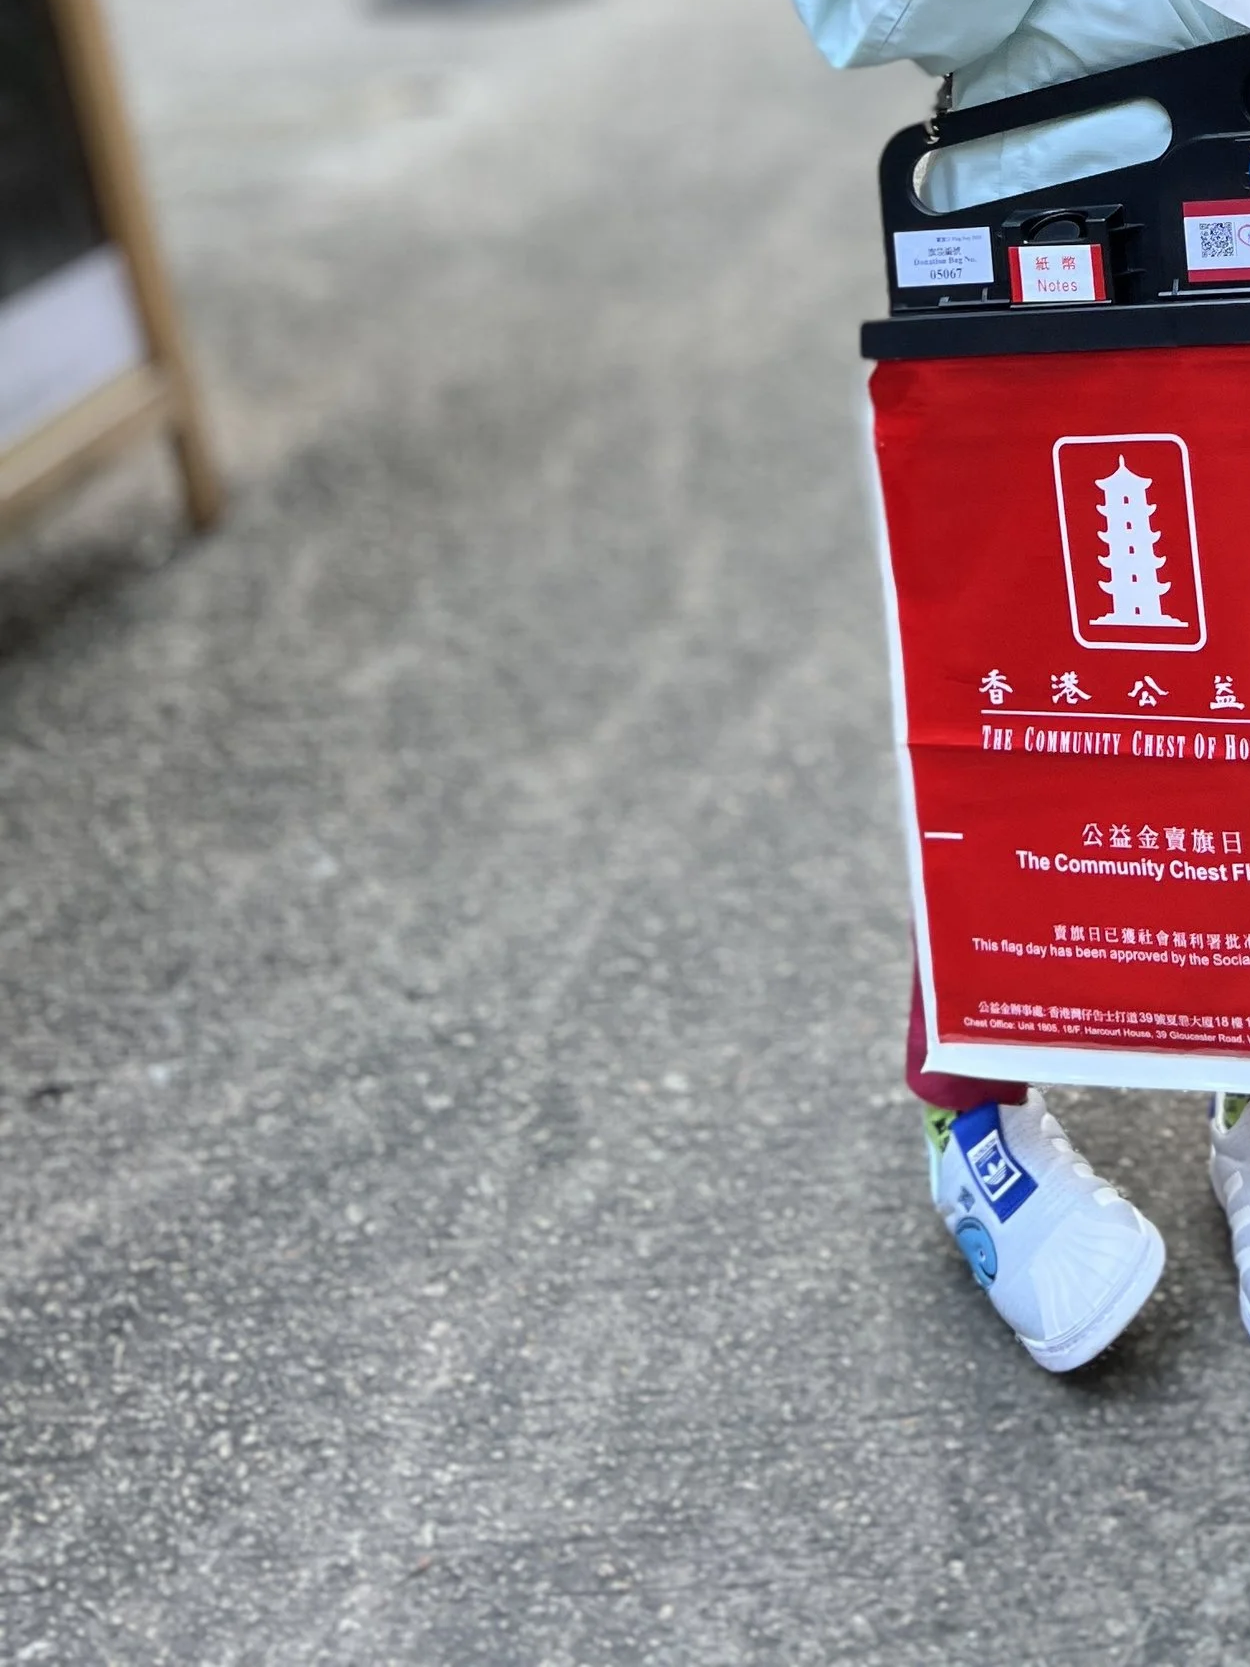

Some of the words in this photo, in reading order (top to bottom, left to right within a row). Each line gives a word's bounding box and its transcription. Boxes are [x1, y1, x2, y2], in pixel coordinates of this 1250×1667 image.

[914, 258, 947, 266] Donation
[948, 256, 963, 265] Bag
[1035, 255, 1077, 271] 紙幣
[930, 268, 962, 280] 05067
[1037, 279, 1078, 292] Notes
[982, 724, 1013, 751] THE
[1024, 726, 1122, 755] COMMUNITY
[1132, 730, 1186, 758] CHEST
[1081, 822, 1243, 855] 公益金賣旗日
[1015, 850, 1051, 871] The
[1053, 852, 1165, 882] Community
[1169, 859, 1229, 882] Chest
[972, 938, 999, 952] This
[1001, 939, 1023, 957] flag
[1026, 942, 1047, 959] day
[1050, 944, 1073, 958] has
[1075, 945, 1107, 959] been
[1109, 948, 1168, 964] approved
[1171, 951, 1187, 968] by
[1188, 953, 1209, 967] the
[963, 1017, 988, 1028] Chest
[989, 1020, 1016, 1030] Office:
[1018, 1022, 1036, 1031] Unit
[1084, 1026, 1121, 1037] Harcourt
[1156, 1030, 1167, 1039] 39
[1169, 1031, 1217, 1042] Gloucester
